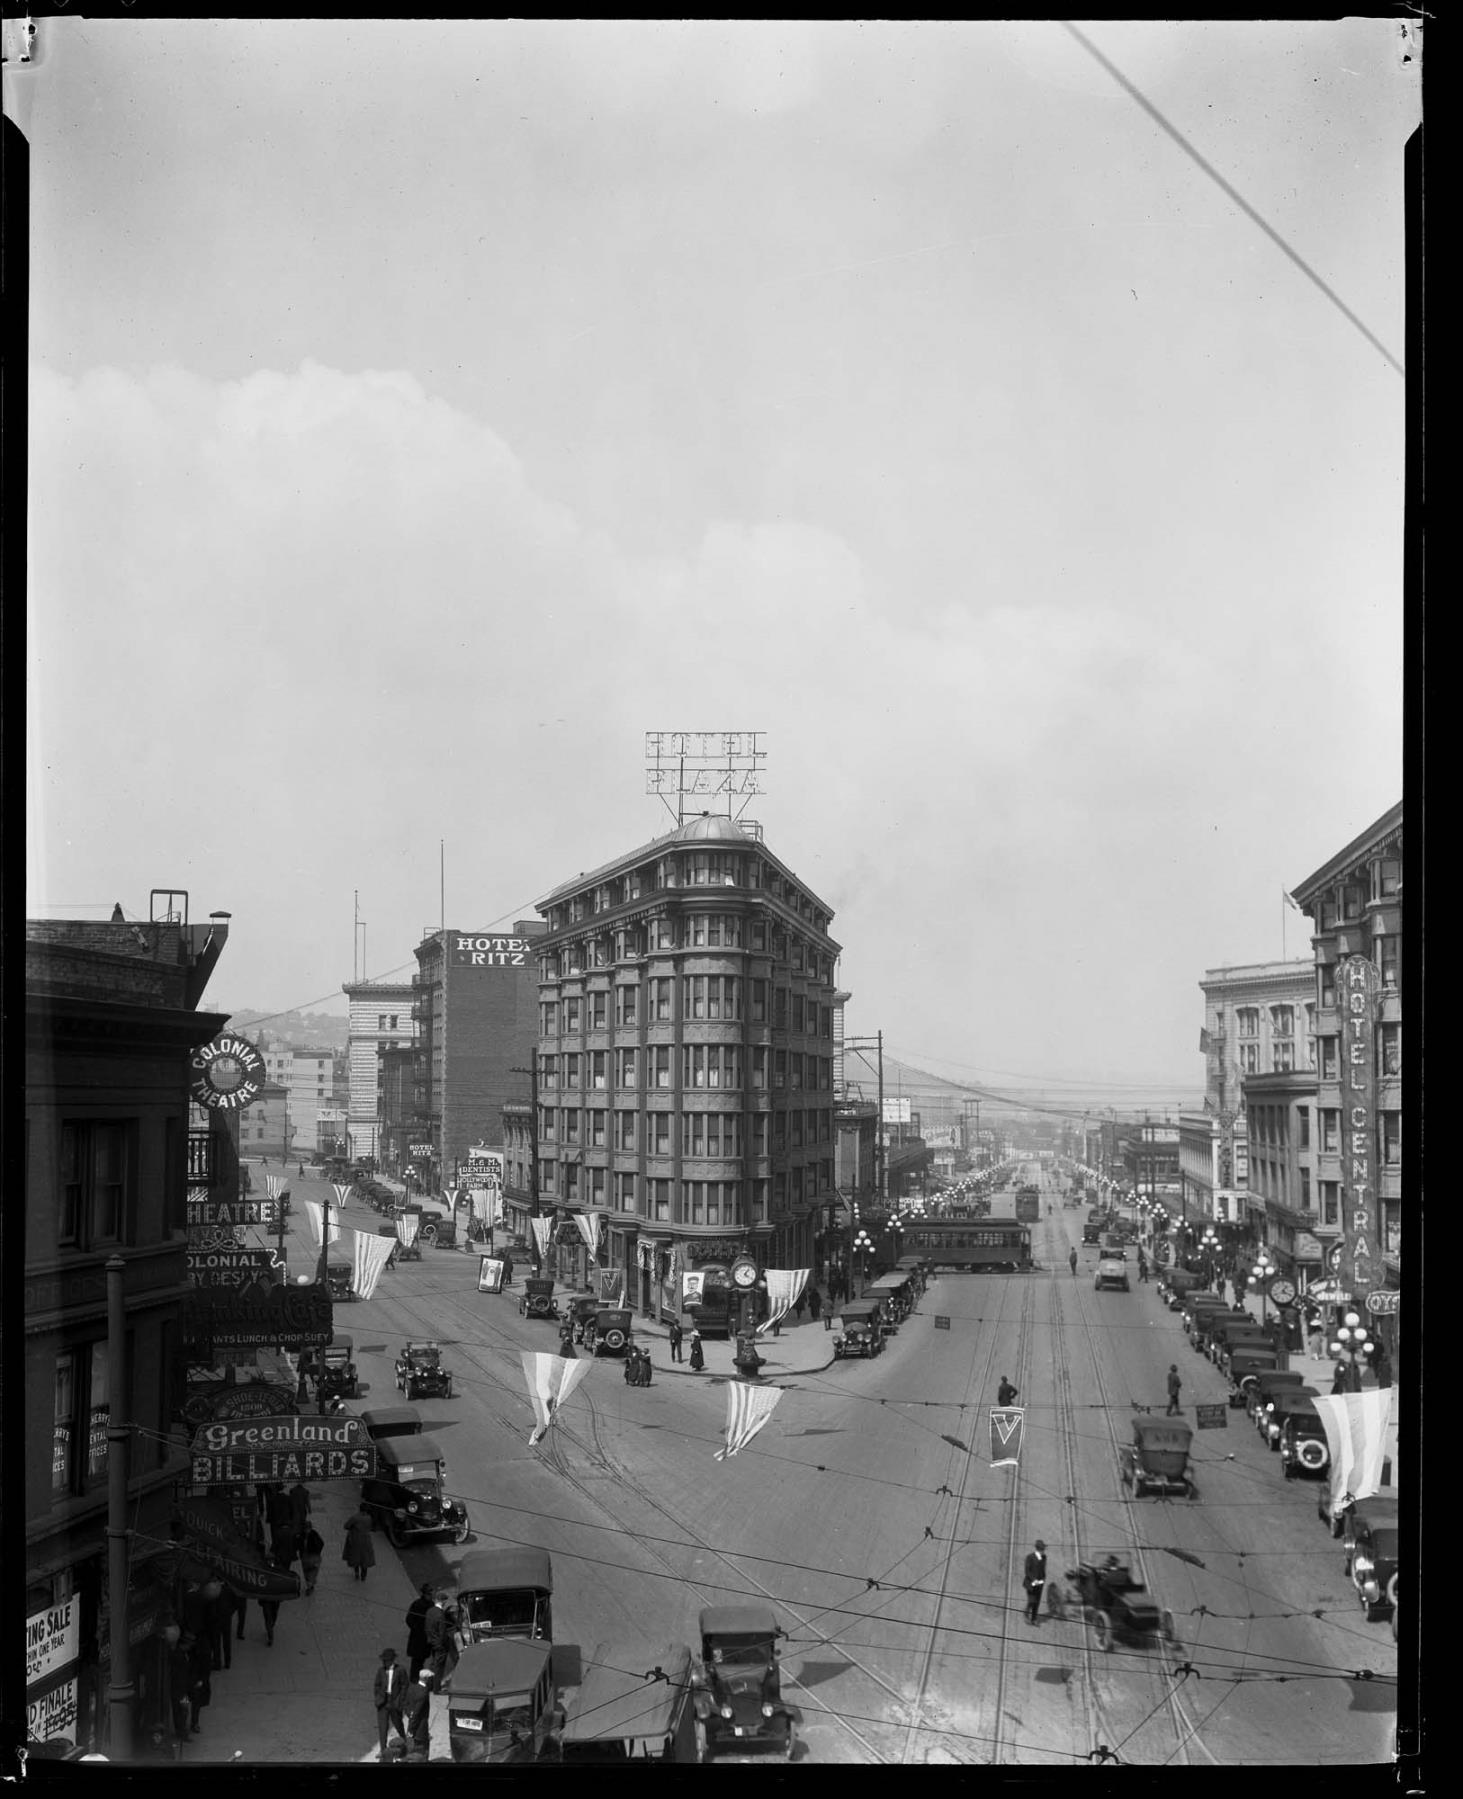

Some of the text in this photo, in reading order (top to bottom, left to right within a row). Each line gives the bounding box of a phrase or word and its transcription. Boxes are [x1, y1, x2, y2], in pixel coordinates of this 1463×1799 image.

[471, 952, 525, 966] RITZ
[192, 1038, 260, 1072] COLONIAL
[192, 1077, 259, 1109] THEATRE
[1350, 966, 1371, 1284] HOTEL CENTRAL
[462, 1166, 501, 1174] DENTISTS
[186, 1202, 273, 1225] HEATRE
[187, 1255, 262, 1268] OLONIAL
[237, 1333, 269, 1344] LUNCH
[278, 1333, 303, 1343] CHOP
[205, 1417, 358, 1451] Greenland
[192, 1449, 370, 1483] BILLIARDS
[187, 1510, 224, 1541] QUICK
[27, 1604, 72, 1649] ING SALE
[39, 1641, 50, 1657] ONE
[50, 1632, 65, 1651] YEAR
[39, 1680, 74, 1718] FINALE
